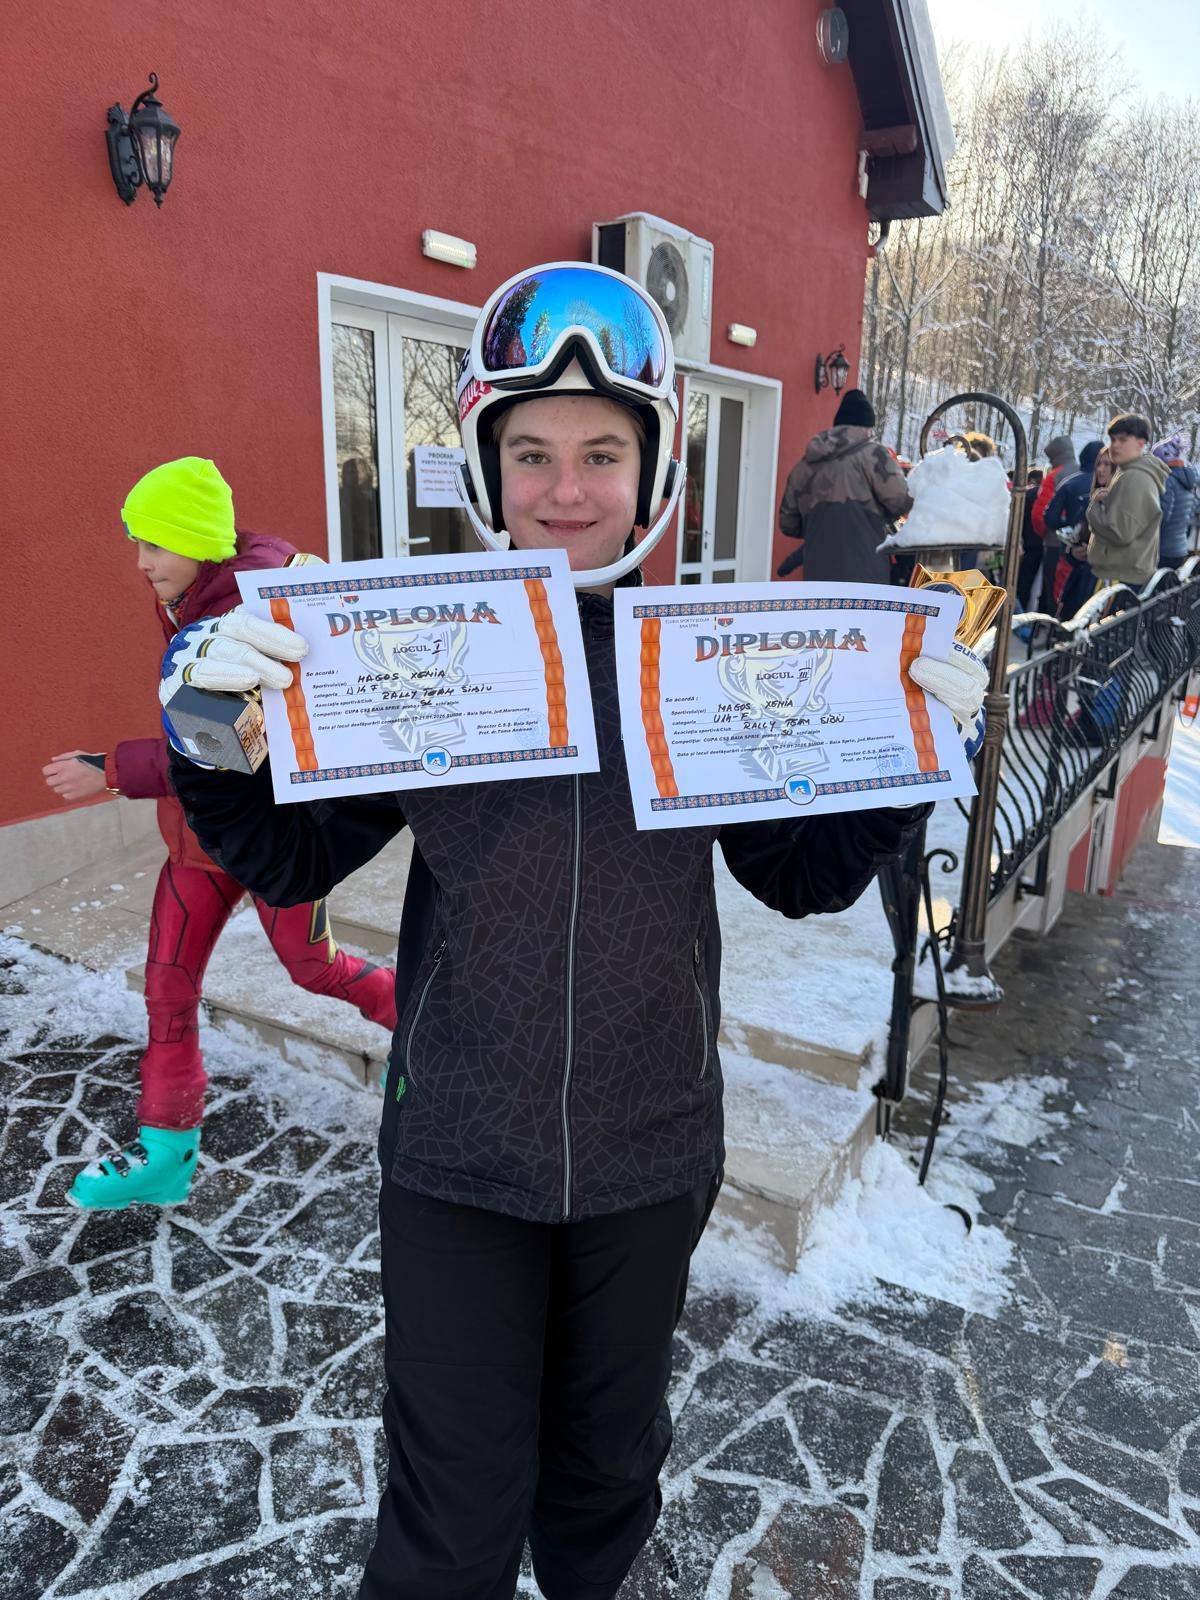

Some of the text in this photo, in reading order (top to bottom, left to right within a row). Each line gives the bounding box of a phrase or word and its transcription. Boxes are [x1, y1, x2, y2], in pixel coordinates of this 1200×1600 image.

[325, 601, 502, 637] DIPLOMA
[393, 644, 431, 654] LOCUL
[695, 627, 869, 662] DIPLOMA
[756, 672, 794, 681] LOCUL
[382, 690, 417, 700] RALLY
[238, 724, 255, 760] LOCUL
